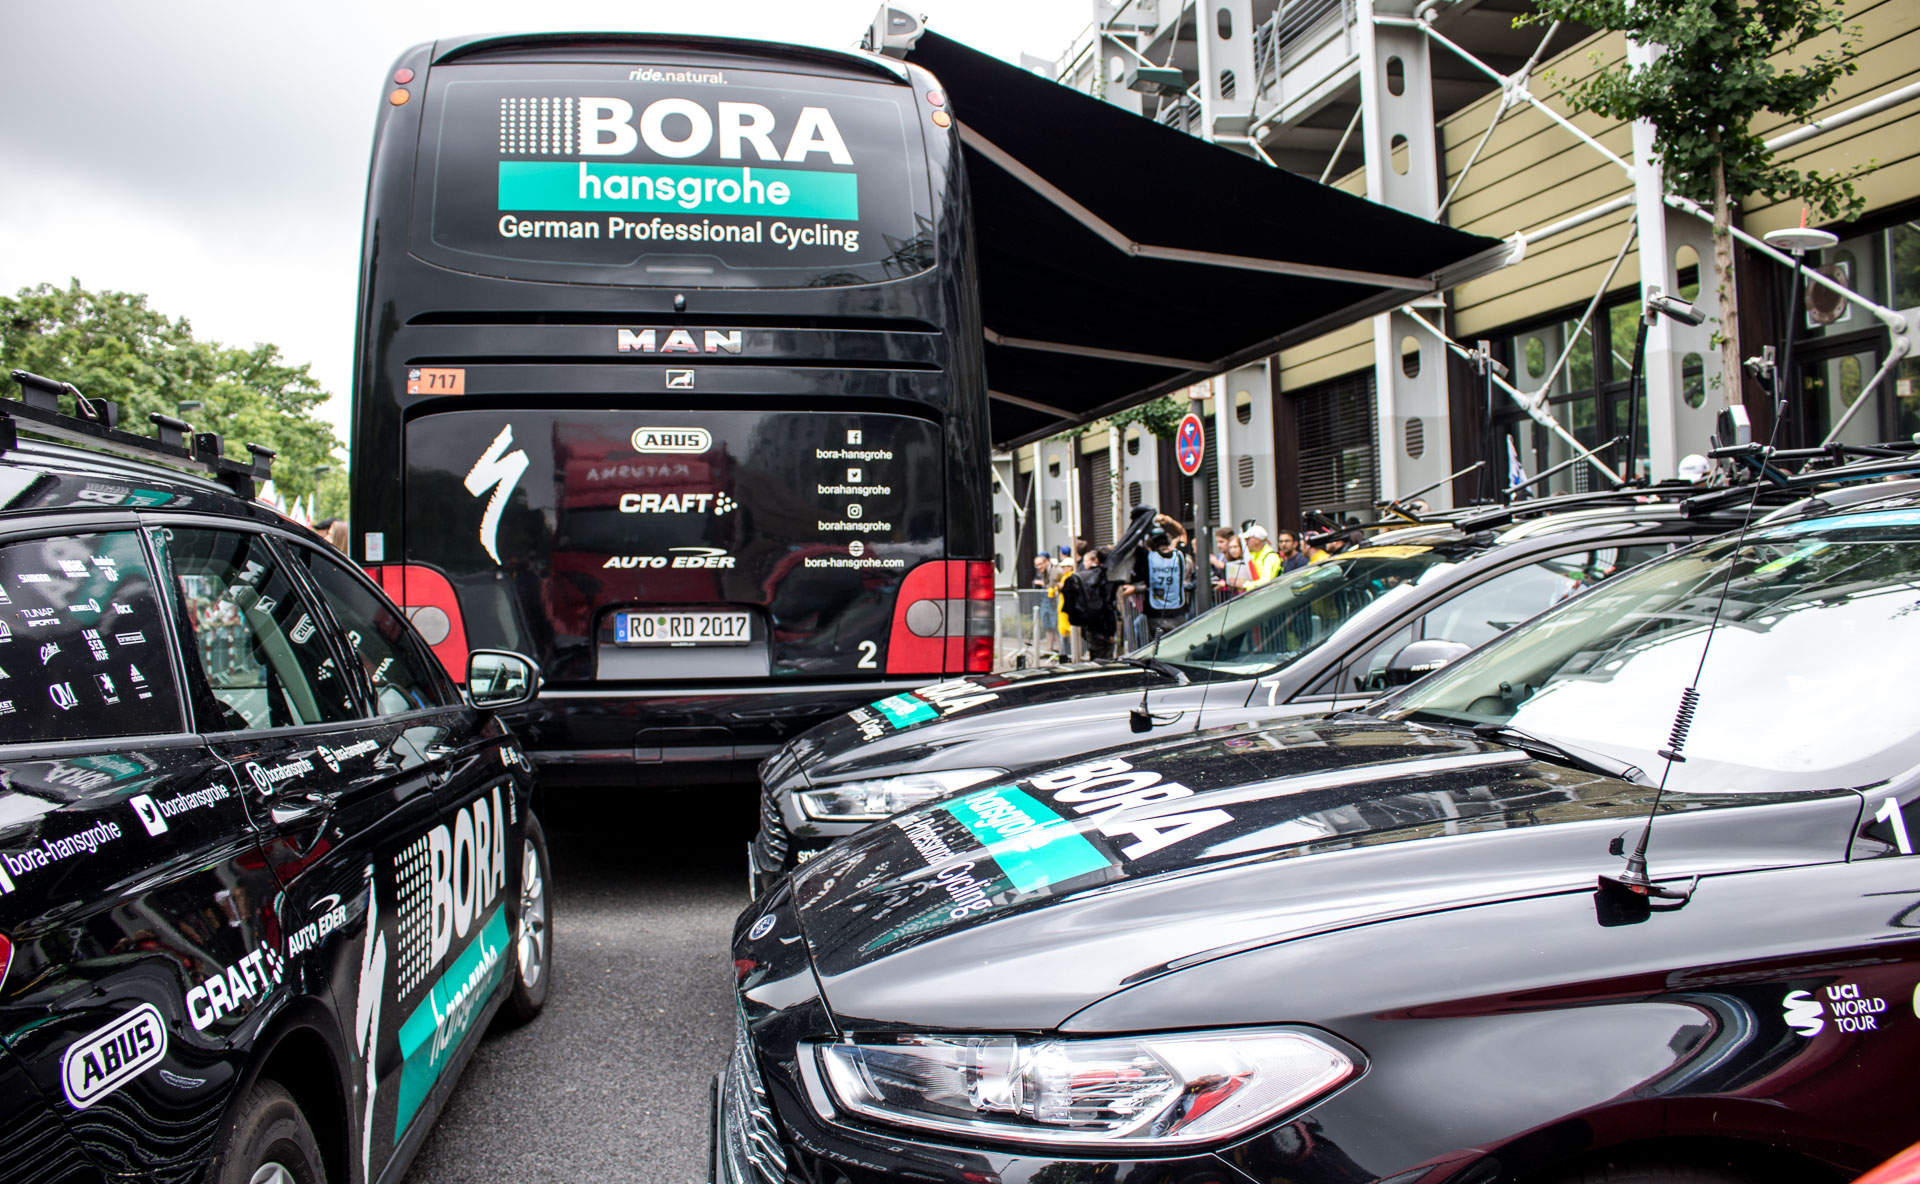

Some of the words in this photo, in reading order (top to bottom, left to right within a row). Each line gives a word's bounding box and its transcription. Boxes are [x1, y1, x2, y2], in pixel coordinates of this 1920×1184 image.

[629, 68, 728, 84] ride.natural.
[577, 96, 855, 166] BORA
[578, 163, 792, 209] hansgrohe
[499, 215, 600, 239] German
[608, 217, 762, 243] Professional
[770, 221, 860, 251] Cycling
[617, 329, 742, 353] MAN
[428, 374, 457, 389] 717
[644, 434, 700, 447] ABUS
[816, 449, 893, 461] bora-hansgrohe
[818, 484, 891, 497] borahansgrohe
[619, 493, 714, 513] CRAFT
[818, 521, 891, 533] borahansgrohe
[602, 556, 668, 568] AUTO
[671, 556, 736, 568] EDER
[804, 557, 905, 570] bora-hansgrohe.com
[630, 617, 654, 637] RO
[670, 617, 694, 637] RD
[700, 616, 747, 637] 2017
[858, 640, 878, 669] 2
[1261, 681, 1280, 706] 7
[157, 782, 230, 818] borahansgrohe
[1026, 757, 1235, 861] BORA
[1875, 797, 1914, 854] 1
[3, 821, 122, 876] bora-hansgrohe
[430, 785, 506, 971] BORA
[931, 861, 993, 919] Cycling
[288, 920, 318, 958] AUTO
[318, 904, 347, 937] EDER
[186, 948, 269, 1031] CRAFT
[1826, 984, 1860, 1000] UCI
[1830, 997, 1887, 1016] WORLD
[1834, 1015, 1877, 1033] TOUR
[82, 1018, 157, 1091] ABUS
